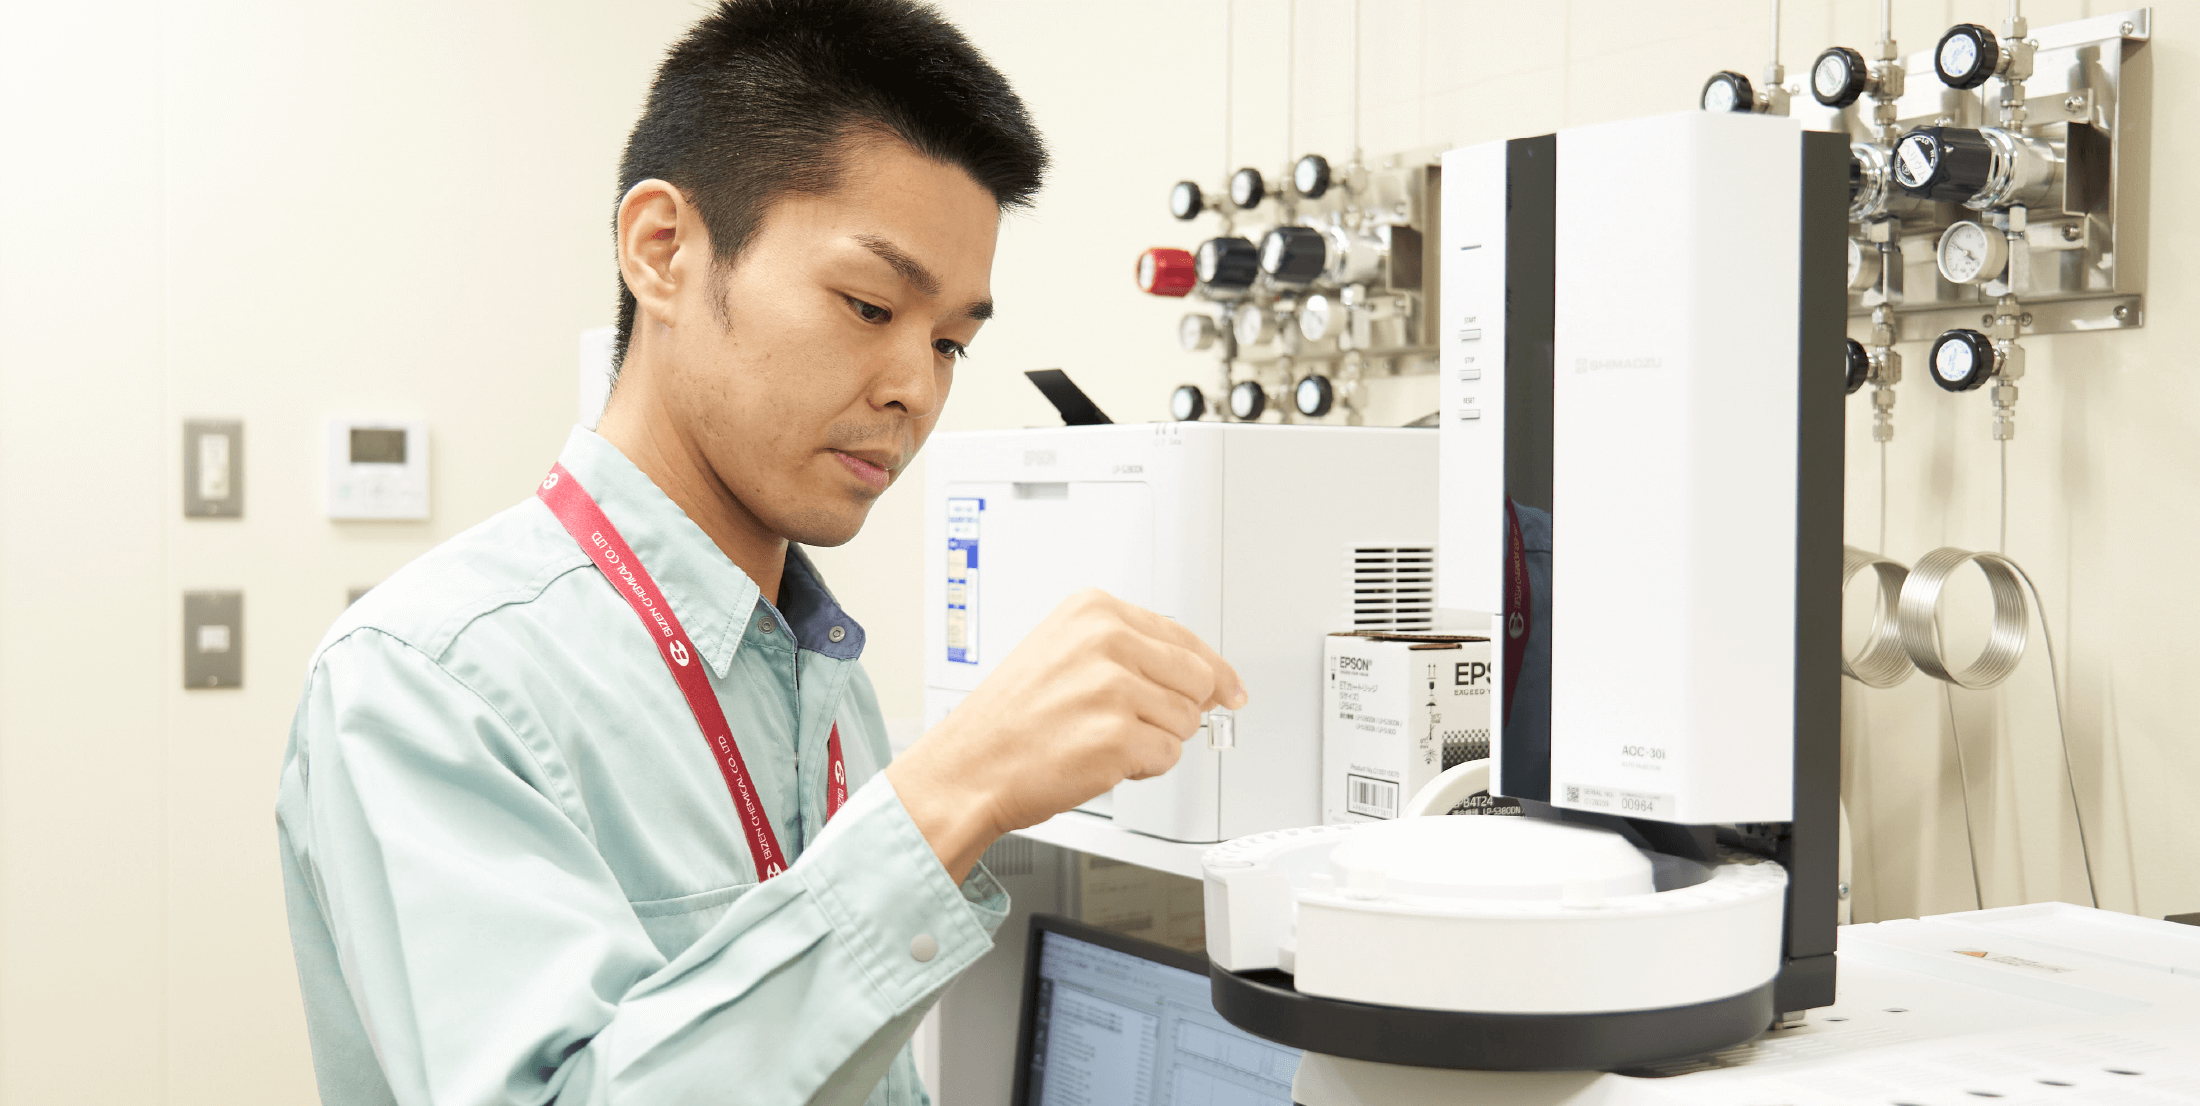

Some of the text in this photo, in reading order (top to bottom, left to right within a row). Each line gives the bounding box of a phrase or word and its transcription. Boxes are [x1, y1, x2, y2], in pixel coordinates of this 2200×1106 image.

[1464, 356, 1475, 364] STOP
[617, 564, 653, 607] CHEMICAL
[649, 607, 674, 638] BIZEN
[1454, 688, 1485, 696] EXCEED
[736, 776, 760, 827] CHEMICAL
[1454, 796, 1494, 808] PB4T24
[1621, 797, 1654, 812] 00964
[756, 828, 772, 860] BIZEN
